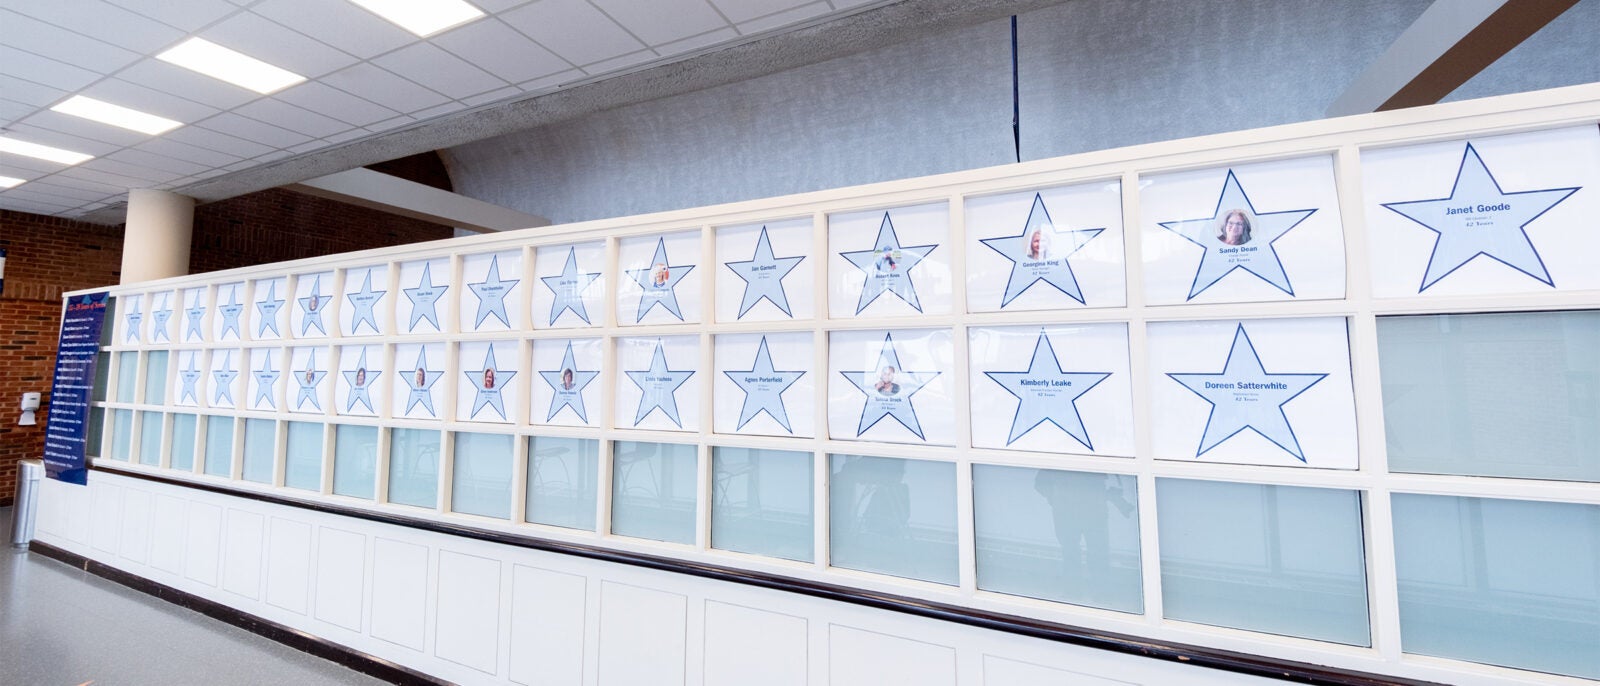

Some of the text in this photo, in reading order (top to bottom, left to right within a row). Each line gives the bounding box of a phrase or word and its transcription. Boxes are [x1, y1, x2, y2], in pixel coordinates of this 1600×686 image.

[1446, 203, 1511, 215] Janet Goode
[1020, 379, 1072, 387] Kimberly Leake
[1237, 381, 1288, 390] Satterwhite
